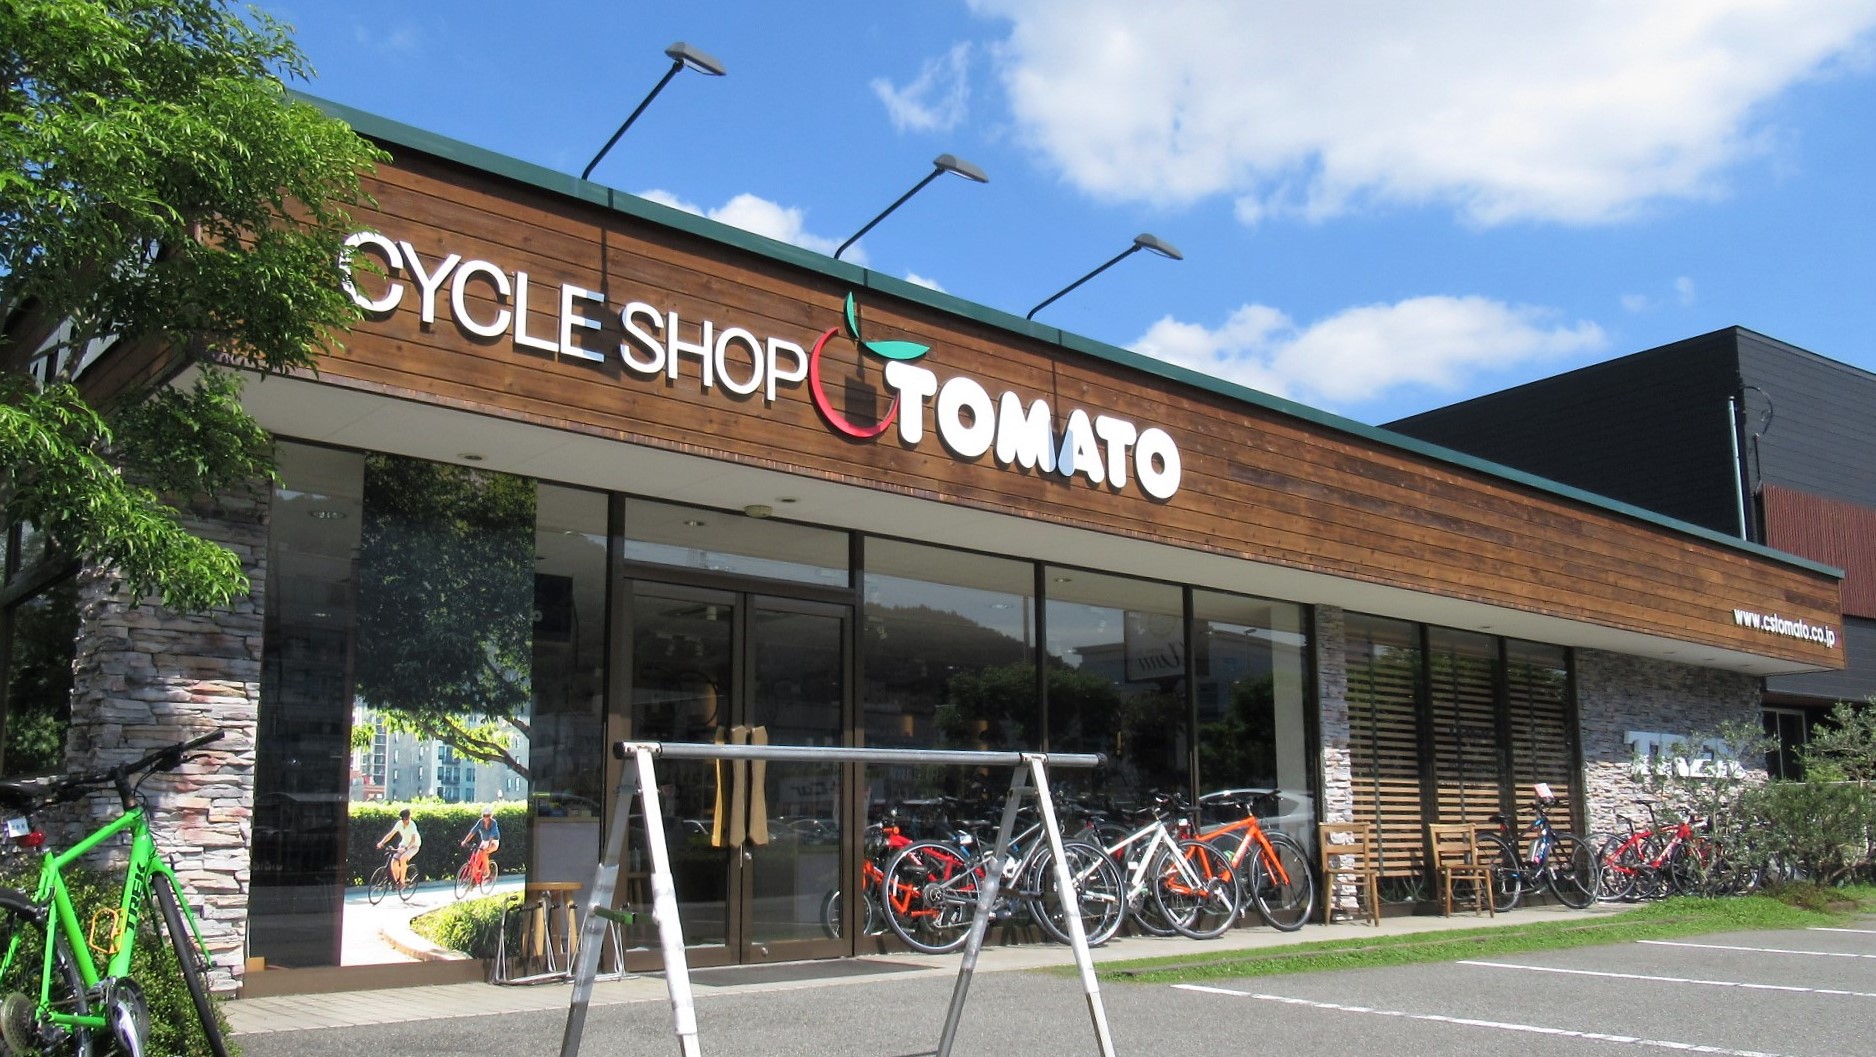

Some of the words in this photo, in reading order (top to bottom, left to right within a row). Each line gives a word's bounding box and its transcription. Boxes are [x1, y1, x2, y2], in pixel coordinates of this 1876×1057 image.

[337, 230, 605, 363] CYCLE
[618, 301, 809, 402] SHOP
[885, 359, 1182, 500] TOMATO
[1733, 608, 1835, 649] www.cstomato.co.jp
[125, 861, 146, 933] TREK
